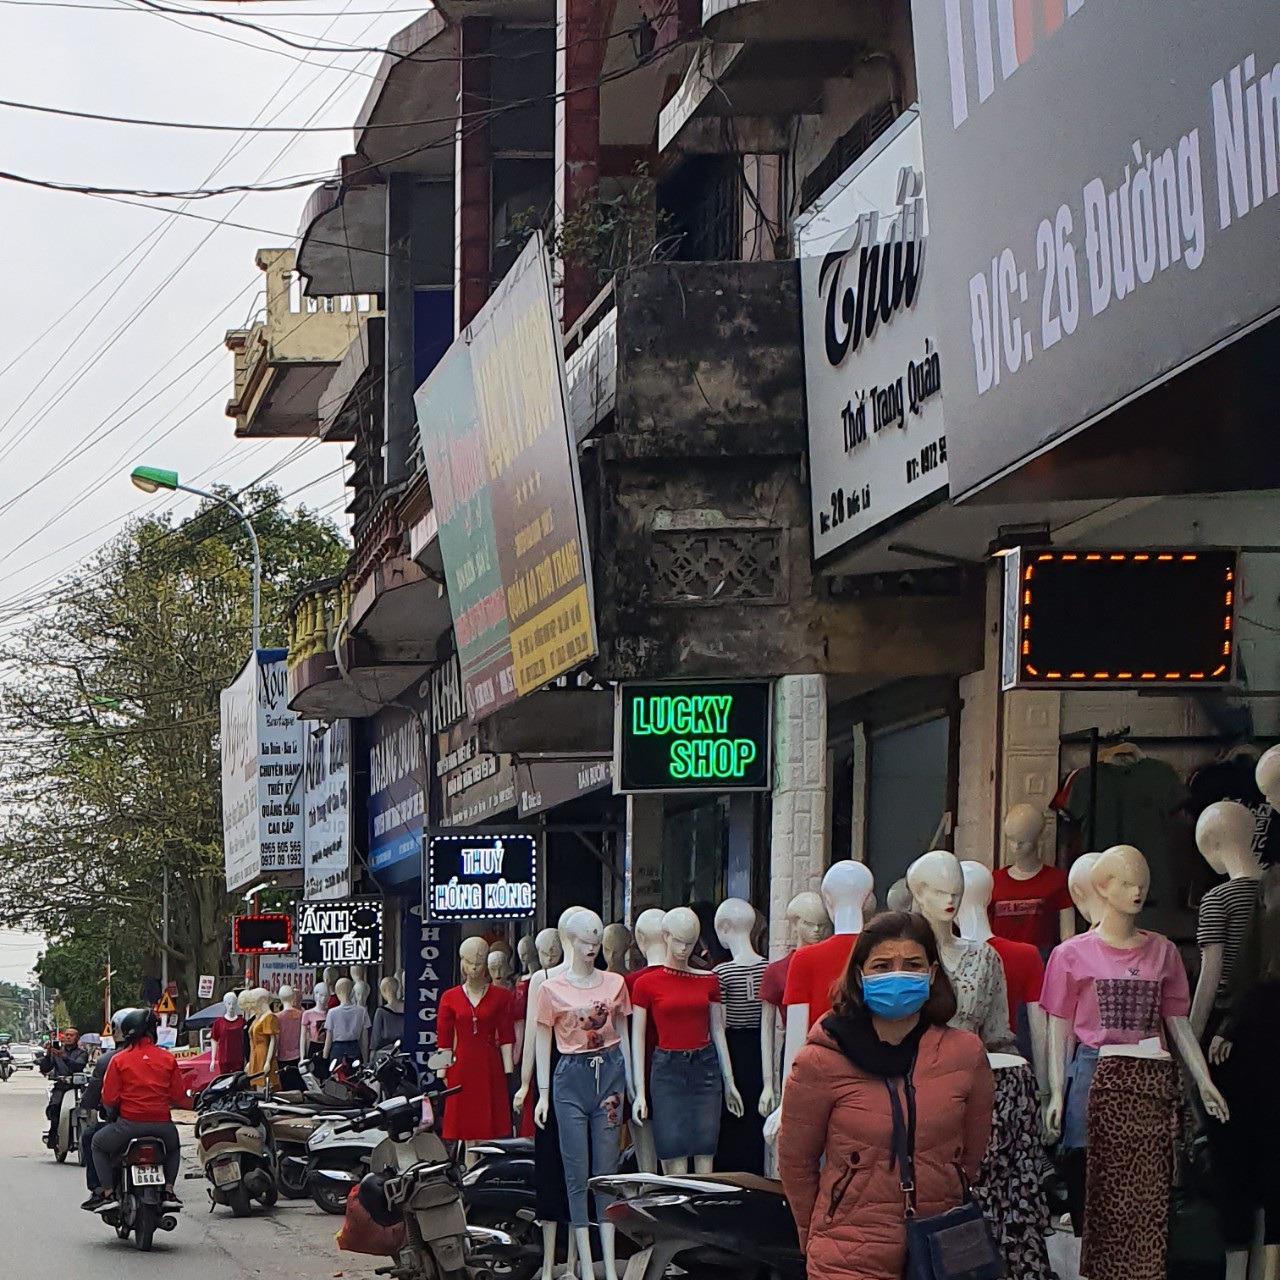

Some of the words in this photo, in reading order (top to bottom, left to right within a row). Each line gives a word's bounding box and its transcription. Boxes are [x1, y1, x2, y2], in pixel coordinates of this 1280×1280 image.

[969, 247, 1034, 395] Đ/C:
[1036, 204, 1080, 350] 26
[1083, 127, 1205, 317] Đường
[841, 389, 867, 453] Thời
[870, 376, 904, 429] Trang
[831, 488, 844, 528] 28
[552, 539, 580, 585] TRANG
[633, 696, 733, 735] LUCKY
[259, 762, 283, 777] CHUYÊN
[670, 739, 756, 778] SHOP
[268, 822, 280, 835] CAO
[281, 818, 294, 834] CẤP
[260, 853, 275, 866] 0937
[287, 853, 301, 865] 1992
[484, 877, 531, 909] KÔNG
[320, 931, 371, 961] TIẾN
